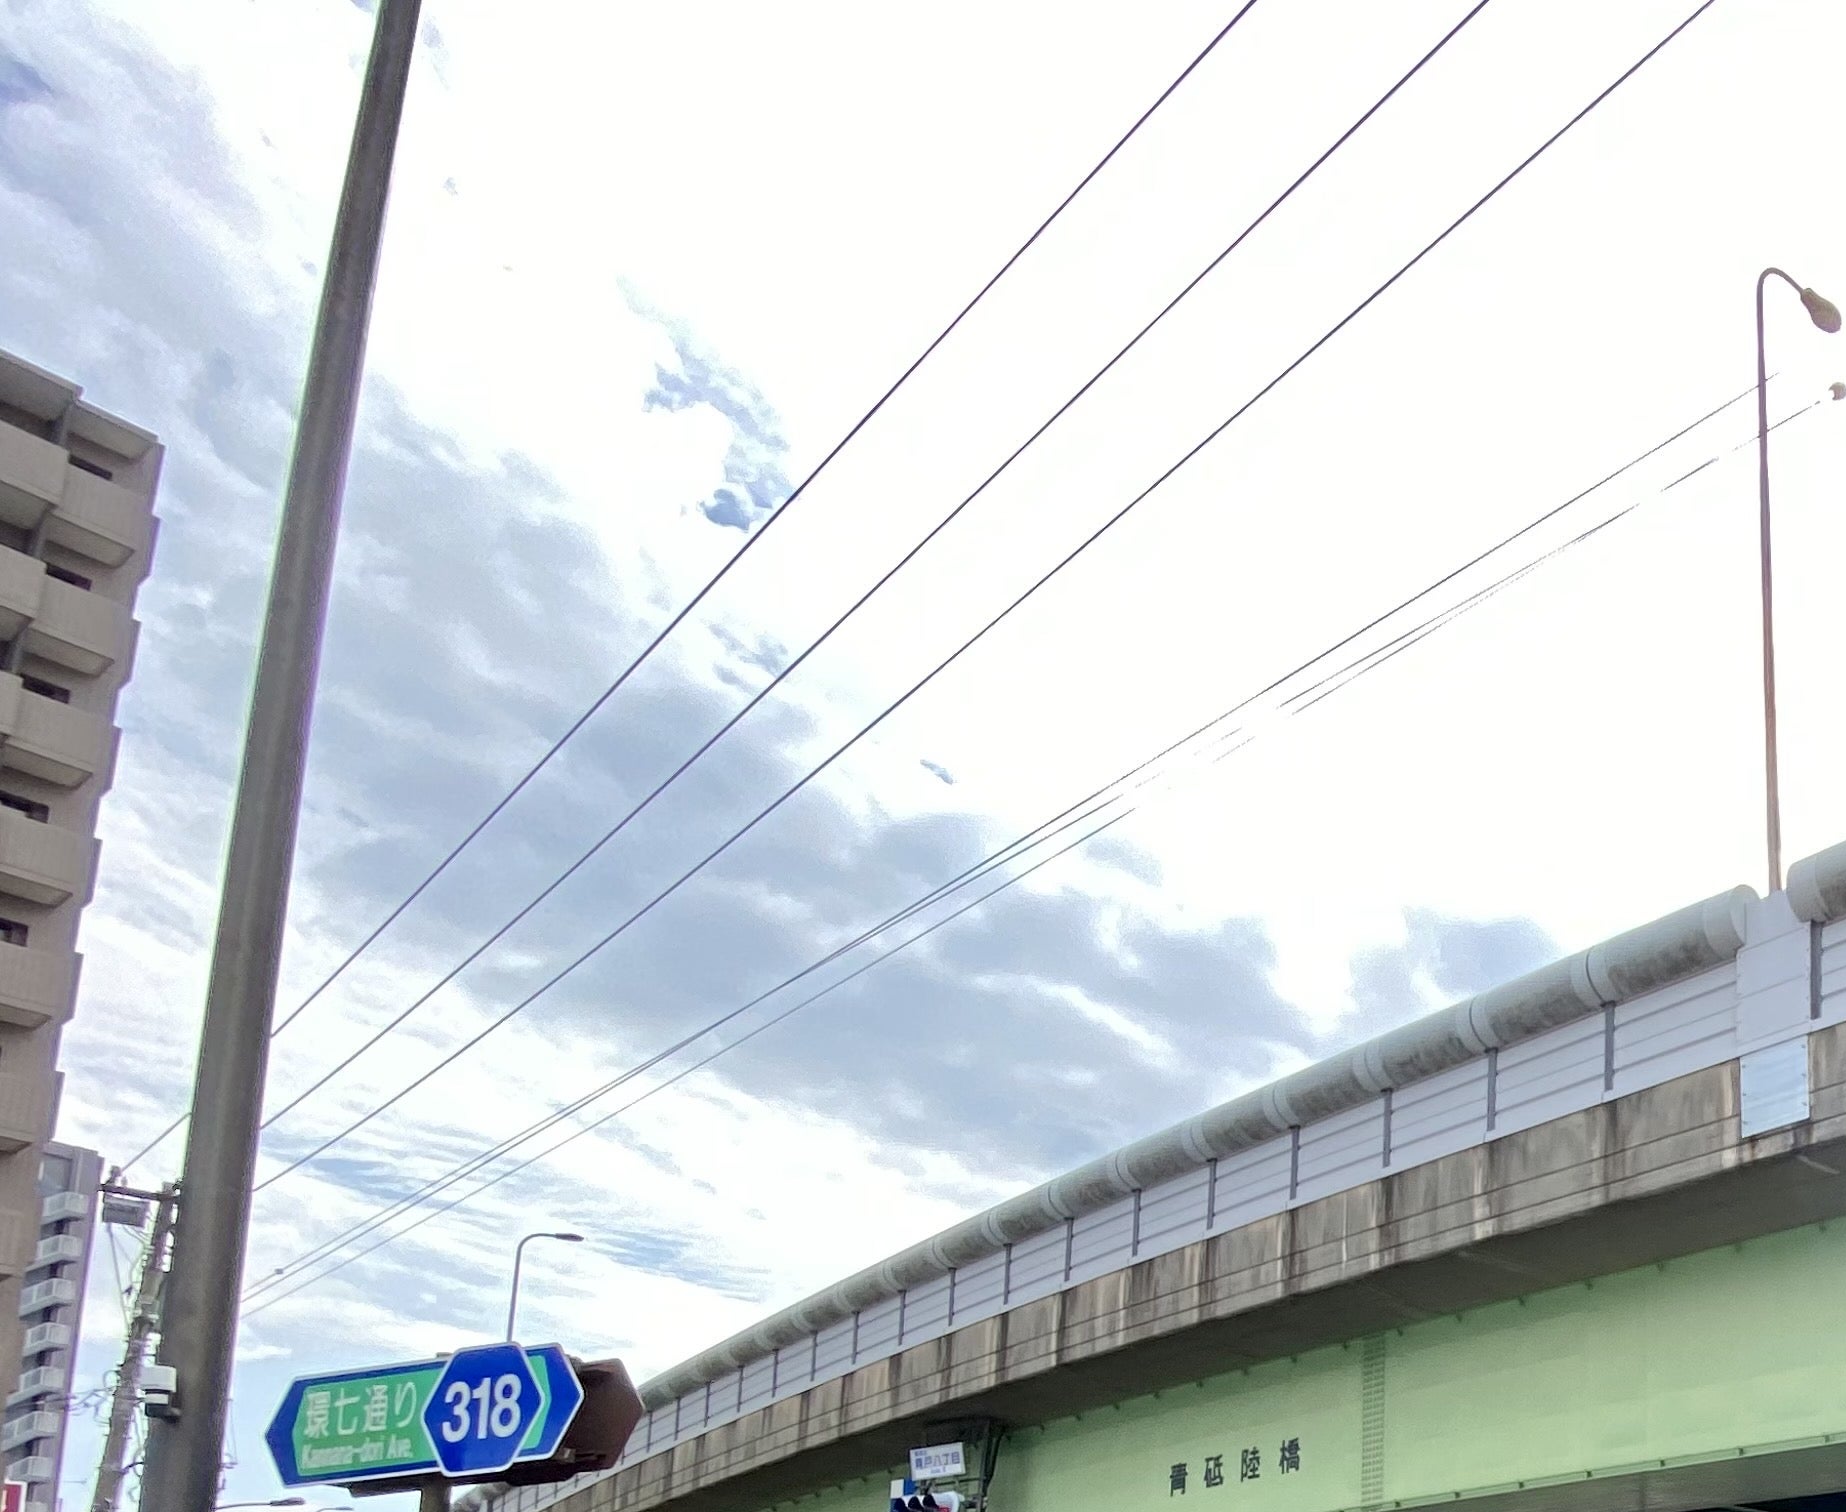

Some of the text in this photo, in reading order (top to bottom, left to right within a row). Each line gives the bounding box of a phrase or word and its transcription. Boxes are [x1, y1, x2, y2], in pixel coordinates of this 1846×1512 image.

[303, 1382, 417, 1438] 環七通り
[442, 1374, 522, 1443] 318
[386, 1435, 414, 1459] Ave.
[1169, 1437, 1301, 1497] 青砥陸橋
